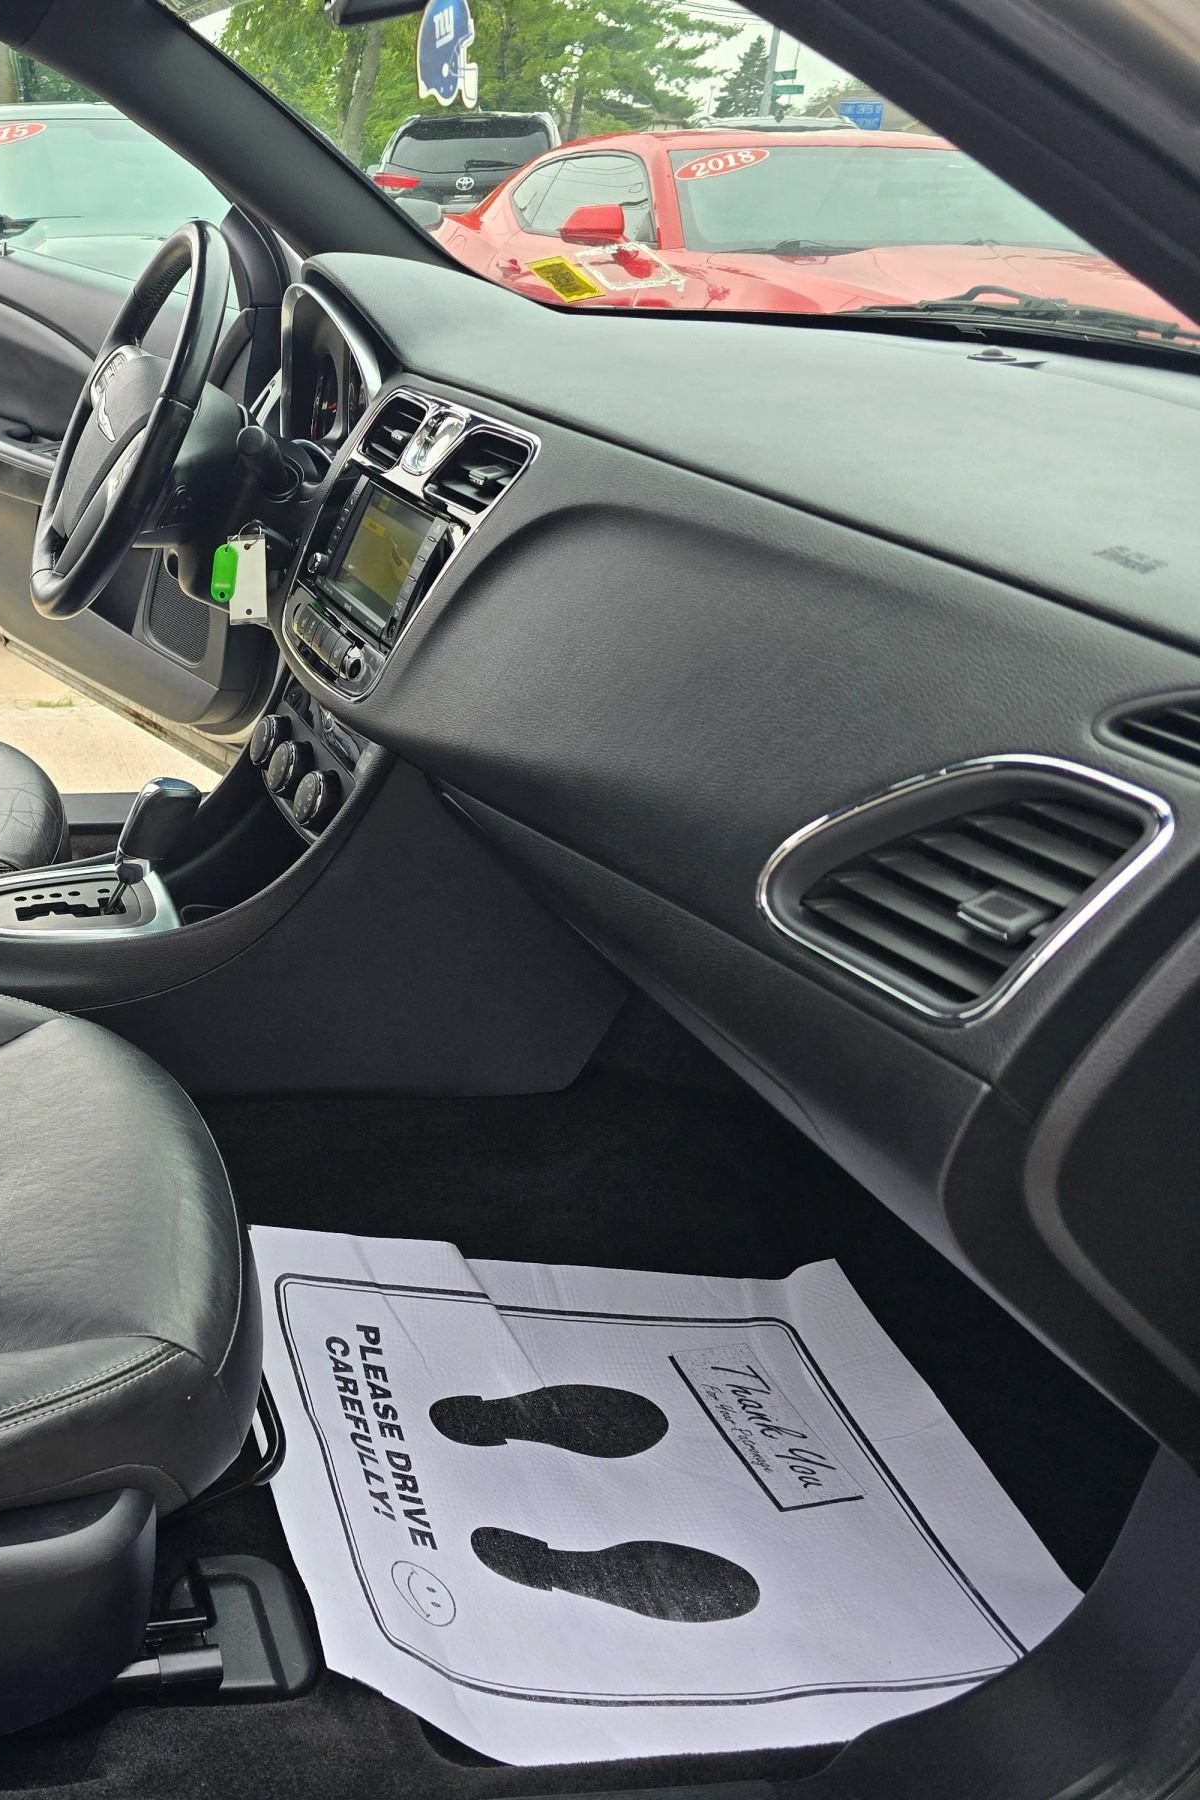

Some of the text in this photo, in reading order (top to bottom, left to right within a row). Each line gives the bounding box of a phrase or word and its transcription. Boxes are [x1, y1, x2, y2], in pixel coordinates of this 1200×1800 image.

[690, 150, 756, 177] 2018
[325, 1335, 397, 1523] CAREFULLY!
[356, 1323, 438, 1551] PLEASE DRIVE
[700, 1383, 723, 1402] For
[711, 1364, 838, 1489] Thank You
